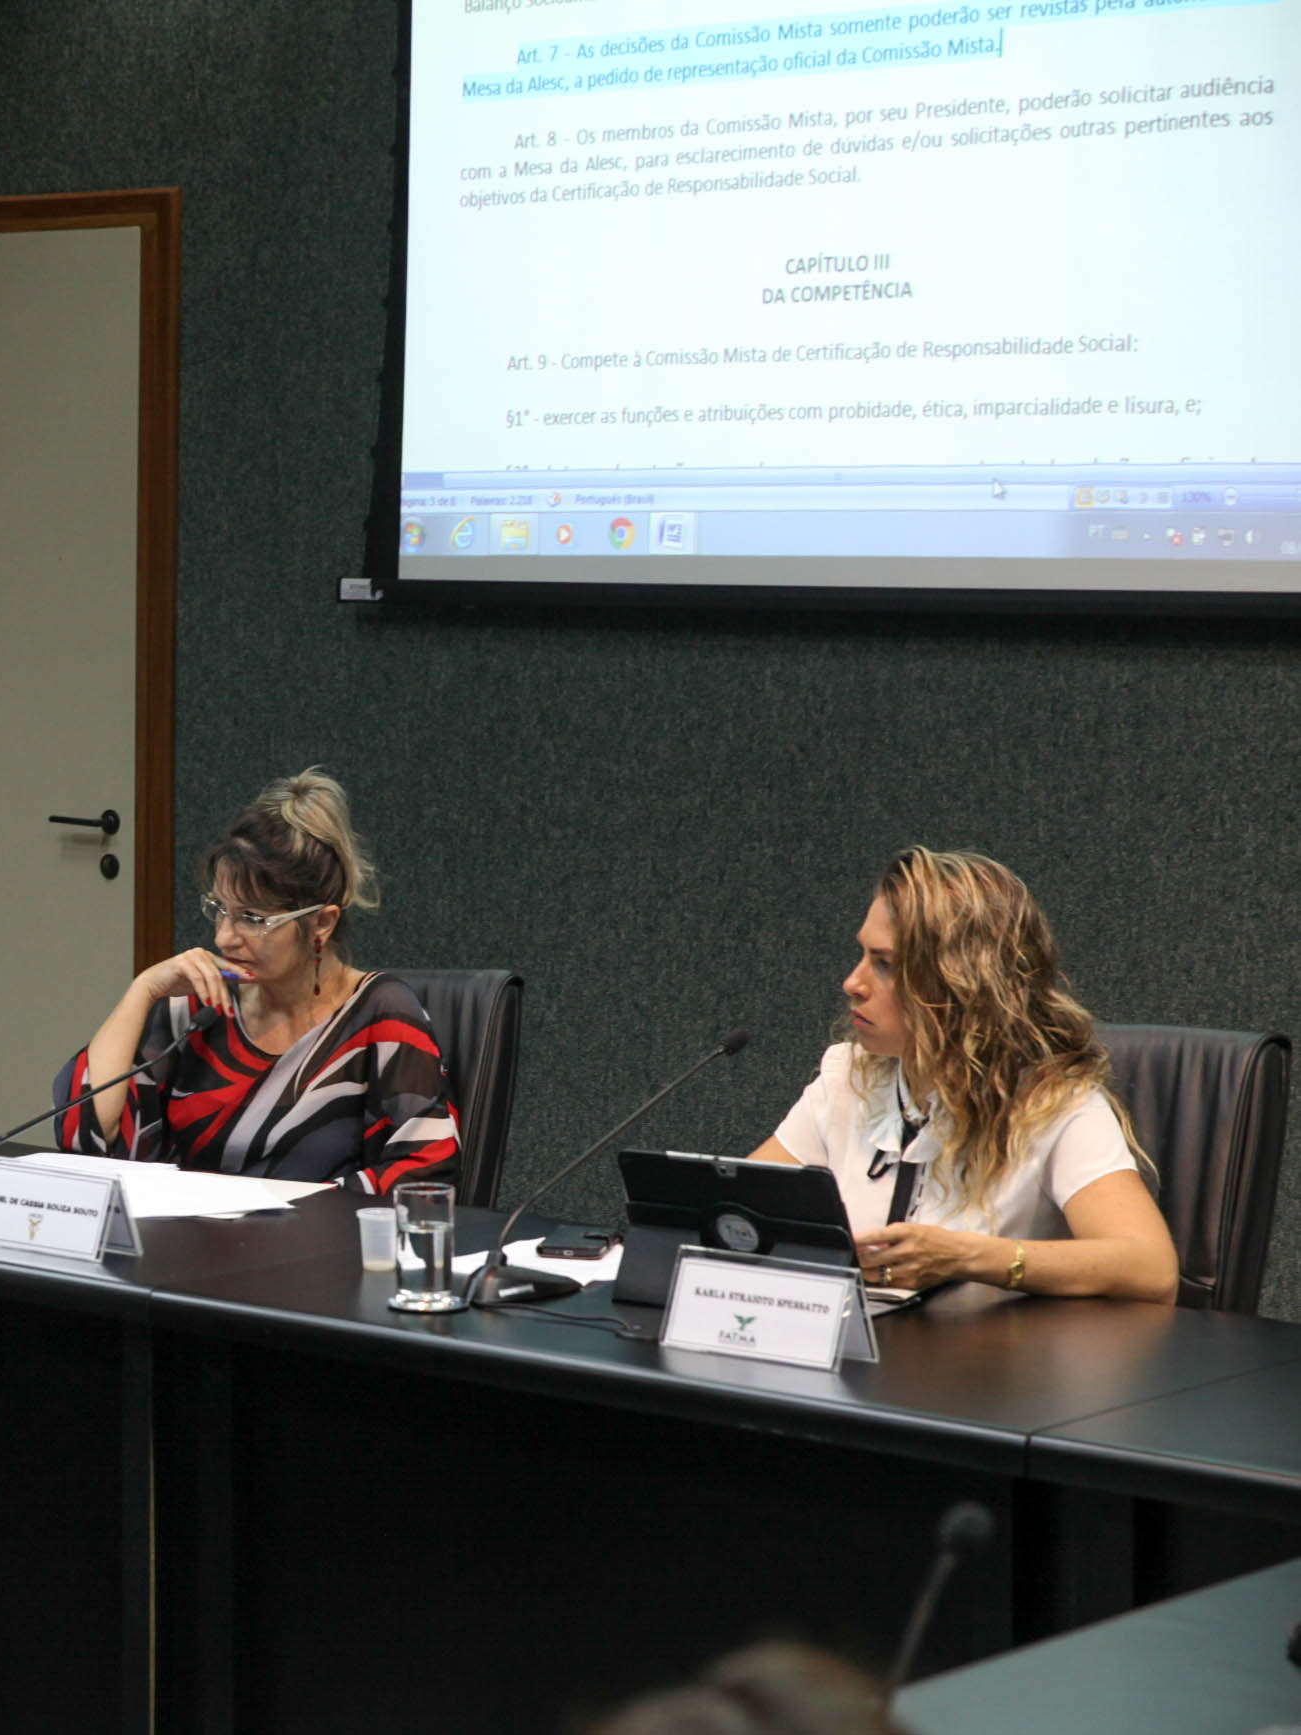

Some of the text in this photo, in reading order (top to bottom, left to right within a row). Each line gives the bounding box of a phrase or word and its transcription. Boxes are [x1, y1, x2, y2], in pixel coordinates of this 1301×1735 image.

[517, 48, 541, 64] Art.
[550, 45, 559, 62] 7
[600, 36, 665, 56] decisões
[671, 34, 689, 50] da
[695, 26, 770, 47] Comissão
[778, 22, 822, 40] Mista
[830, 15, 901, 36] somente
[908, 6, 980, 32] poderão
[987, 6, 1011, 21] ser
[1020, 0, 1088, 18] revistas
[462, 81, 501, 96] Mesa
[506, 78, 523, 94] da
[574, 75, 583, 88] a
[588, 67, 639, 91] pedido
[644, 66, 663, 82] de
[668, 55, 778, 83] representação
[783, 49, 831, 71] oficial
[837, 48, 857, 66] da
[862, 40, 942, 64] Comissão
[514, 133, 539, 149] Art.
[547, 131, 556, 146] 8
[576, 129, 596, 145] Os
[602, 124, 674, 142] membros
[680, 120, 698, 136] da
[706, 114, 781, 135] Comissão
[845, 110, 873, 128] por
[880, 107, 908, 122] seu
[916, 98, 1010, 118] Presidente,
[1019, 89, 1092, 115] poderão
[1099, 85, 1174, 104] solicitar
[1180, 76, 1274, 98] audiência
[460, 167, 492, 181] com
[499, 166, 507, 178] a
[514, 161, 553, 176] Mesa
[560, 157, 578, 173] da
[635, 154, 669, 172] para
[676, 144, 796, 165] esclarecimento
[803, 140, 823, 156] de
[830, 135, 894, 154] dúvidas
[902, 130, 942, 152] e/ou
[951, 123, 1052, 147] solicitações
[1060, 120, 1116, 139] outras
[1124, 111, 1230, 139] pertinentes
[1239, 111, 1274, 127] aos
[459, 190, 526, 210] objetivos
[530, 187, 548, 202] da
[552, 180, 640, 202] Certificação
[645, 180, 663, 196] de
[668, 170, 804, 196] Responsabilidade
[786, 253, 889, 275] CAPÍTULO III
[762, 280, 912, 304] DA COMPETÊNCIA
[507, 356, 533, 370] Art.
[538, 354, 547, 370] 9
[561, 352, 628, 372] Compete
[633, 352, 642, 367] à
[646, 348, 718, 366] Comissão
[723, 347, 767, 363] Mista
[772, 346, 791, 362] de
[796, 342, 891, 364] Certificação
[896, 341, 918, 358] de
[923, 336, 1074, 361] Responsabilidade
[543, 412, 596, 425] exercer
[600, 412, 617, 424] as
[622, 406, 679, 428] funções
[684, 410, 694, 422] e
[698, 404, 784, 424] atribuições
[788, 406, 823, 420] com
[973, 396, 1103, 419] imparcialidade
[1107, 400, 1119, 413] e
[695, 1287, 725, 1299] KARLA
